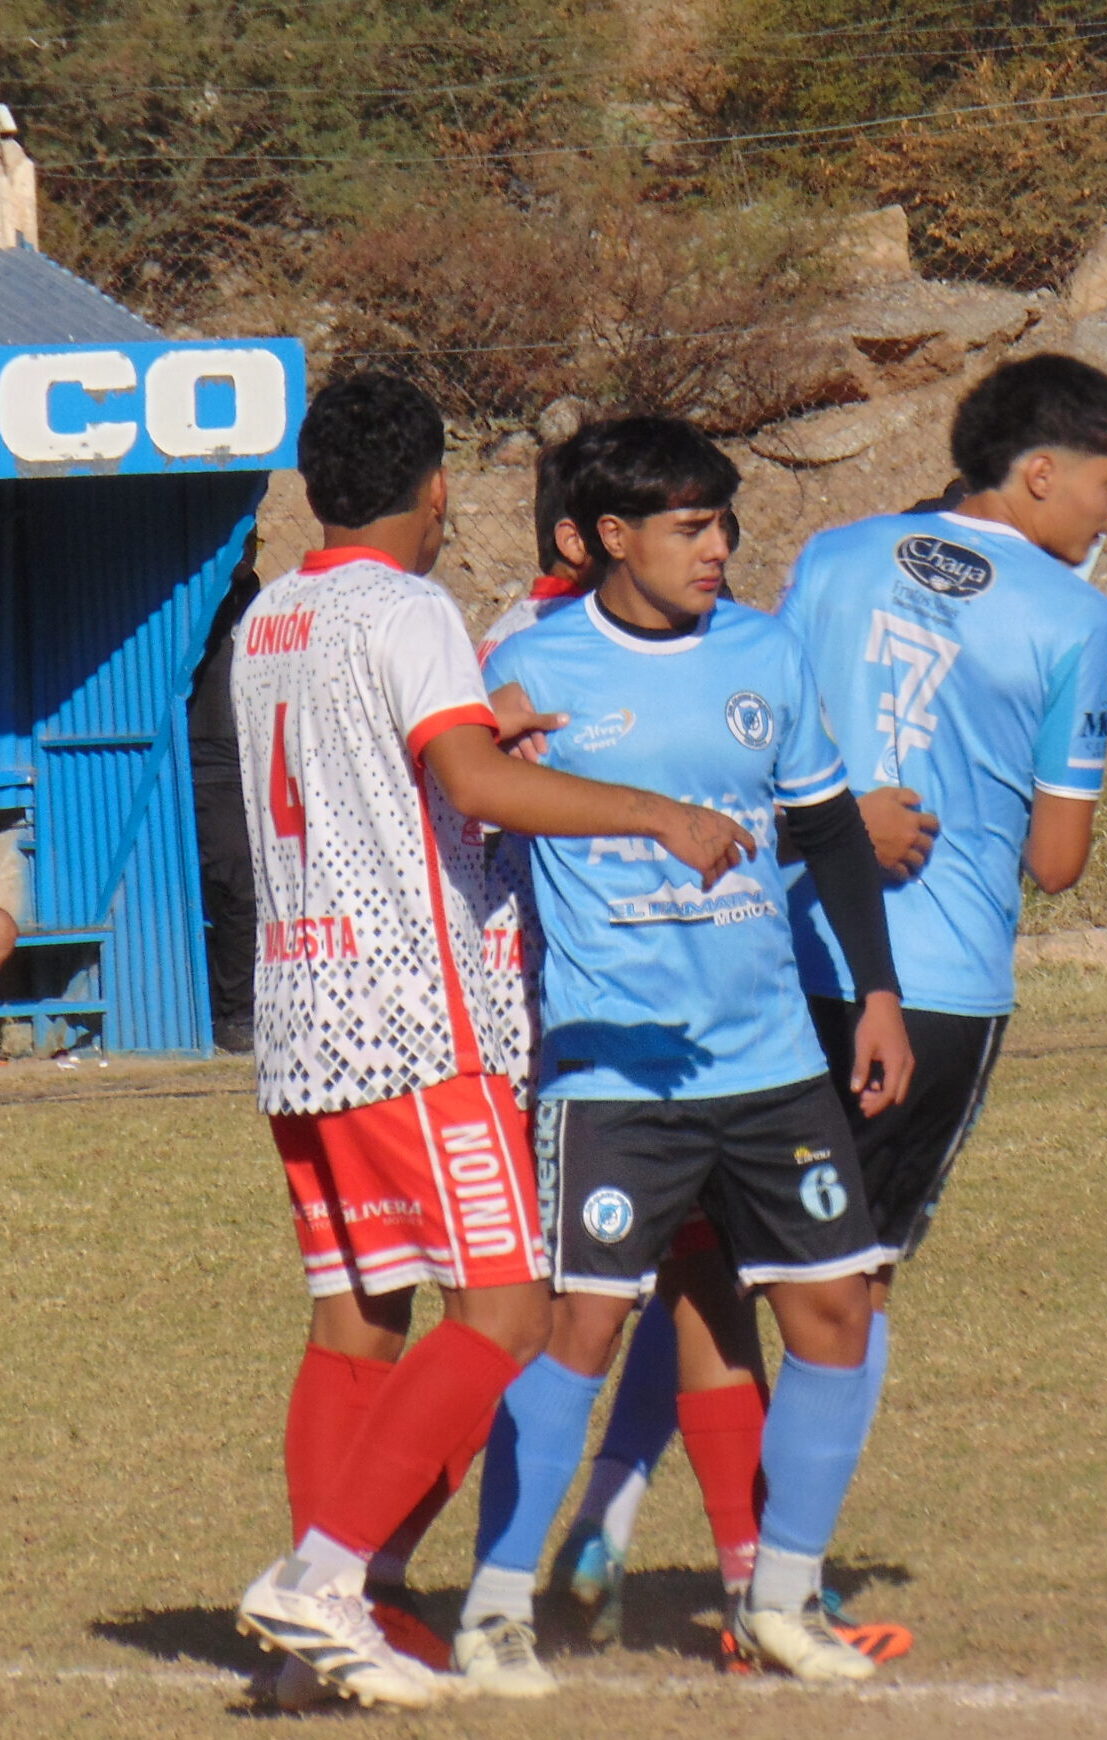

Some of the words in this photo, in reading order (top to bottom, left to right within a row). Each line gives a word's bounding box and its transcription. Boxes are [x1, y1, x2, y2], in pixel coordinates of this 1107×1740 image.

[904, 538, 987, 587] Chaya
[246, 602, 316, 657] UNIÓN
[441, 1121, 517, 1259] UNION
[800, 1165, 848, 1222] 6
